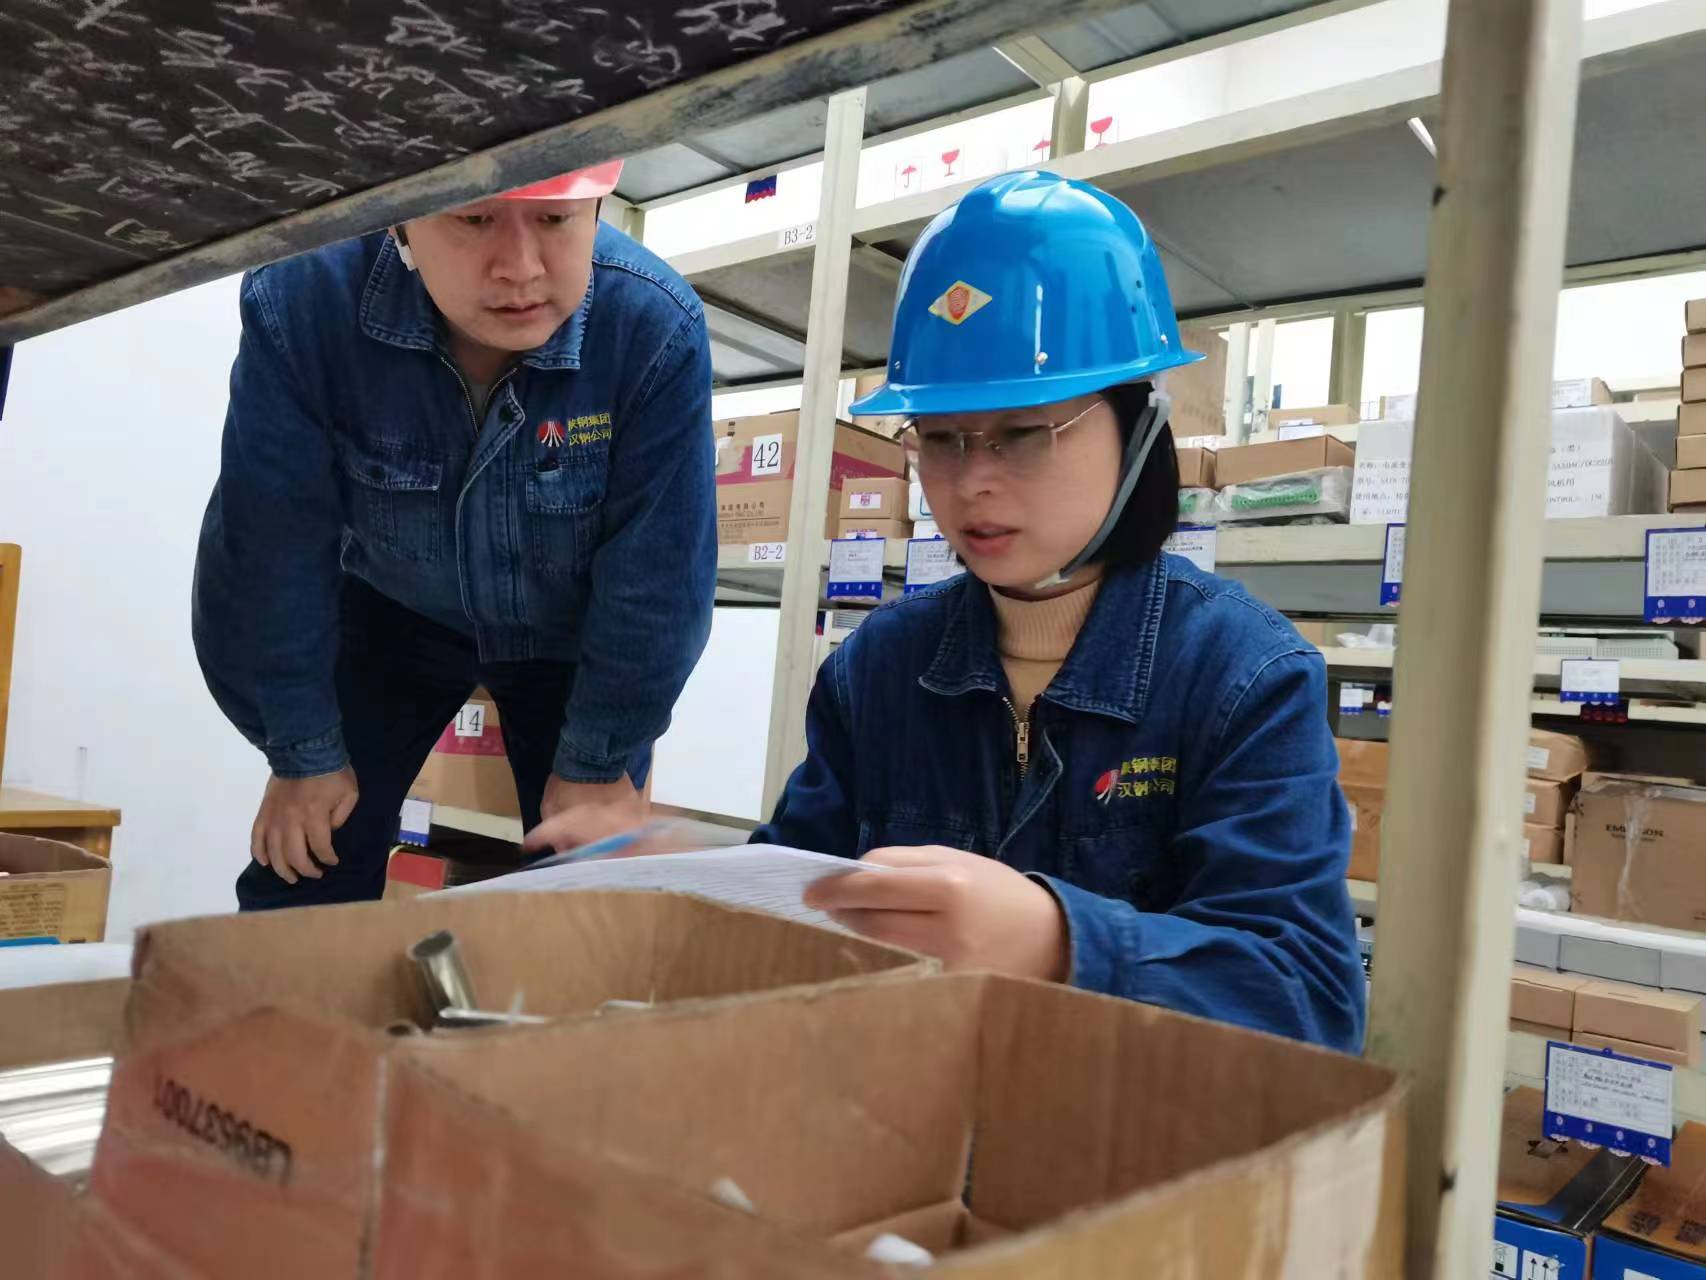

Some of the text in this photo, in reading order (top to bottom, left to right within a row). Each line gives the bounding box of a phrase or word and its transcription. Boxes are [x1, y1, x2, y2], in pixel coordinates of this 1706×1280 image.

[784, 224, 813, 245] B3-2
[753, 441, 780, 469] 42
[753, 544, 784, 561] B2-2
[456, 709, 482, 732] 14
